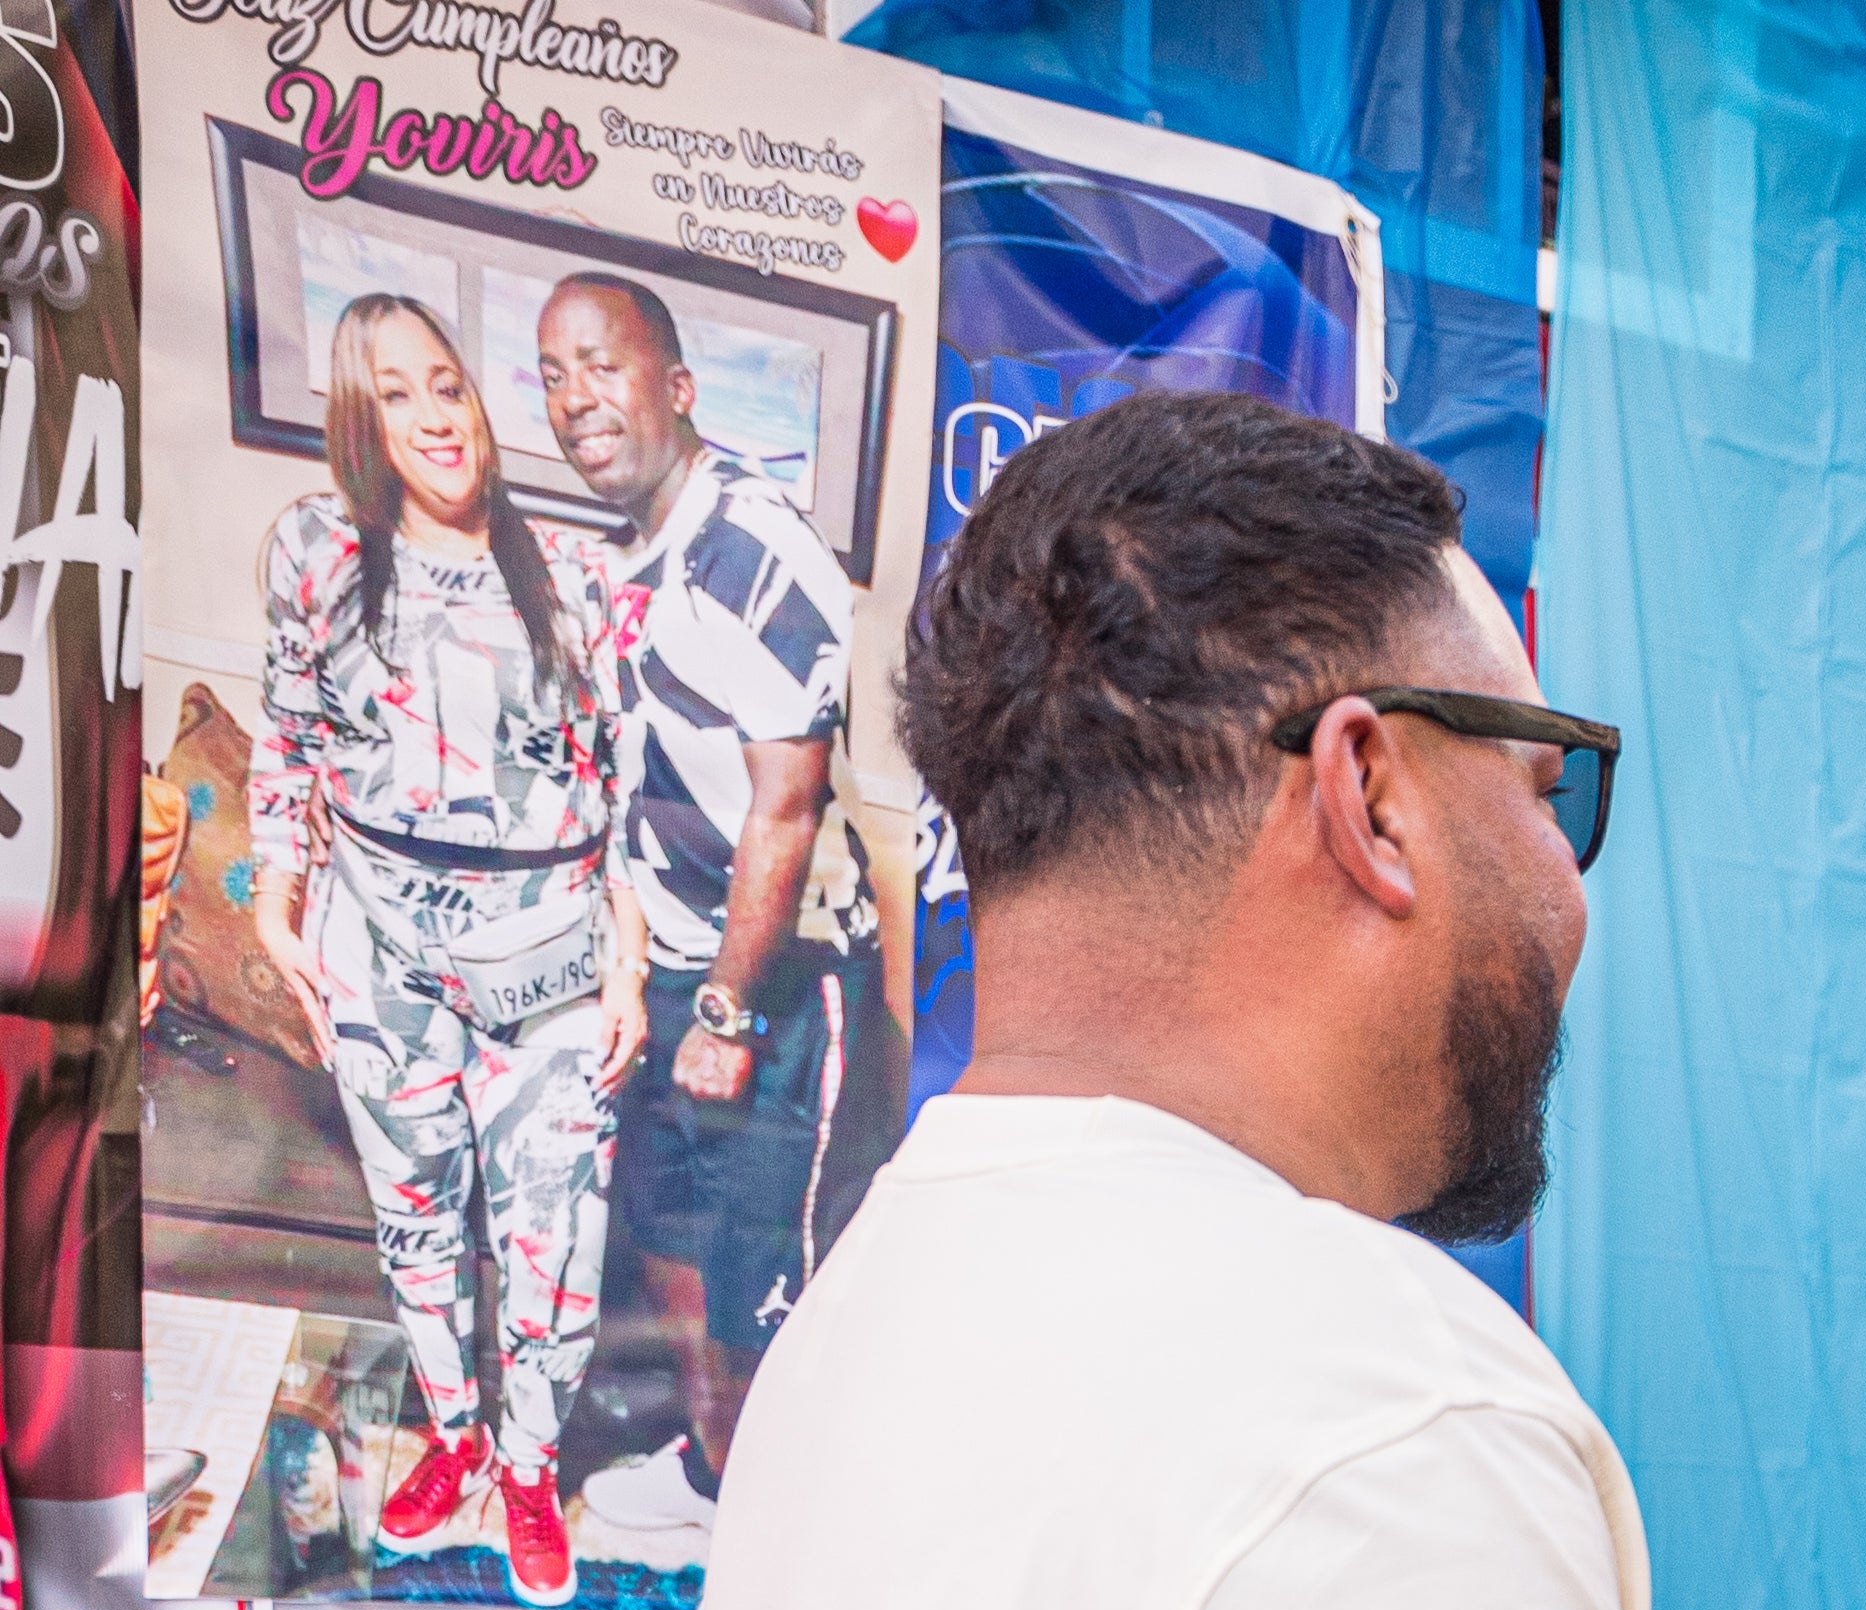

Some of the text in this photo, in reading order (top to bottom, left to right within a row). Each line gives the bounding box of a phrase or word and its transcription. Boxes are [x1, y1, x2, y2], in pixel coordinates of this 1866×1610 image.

[265, 64, 599, 199] Yoviris
[600, 105, 865, 181] Siempre Vivirás
[653, 172, 845, 226] en Nuestros
[679, 212, 846, 277] Corazones
